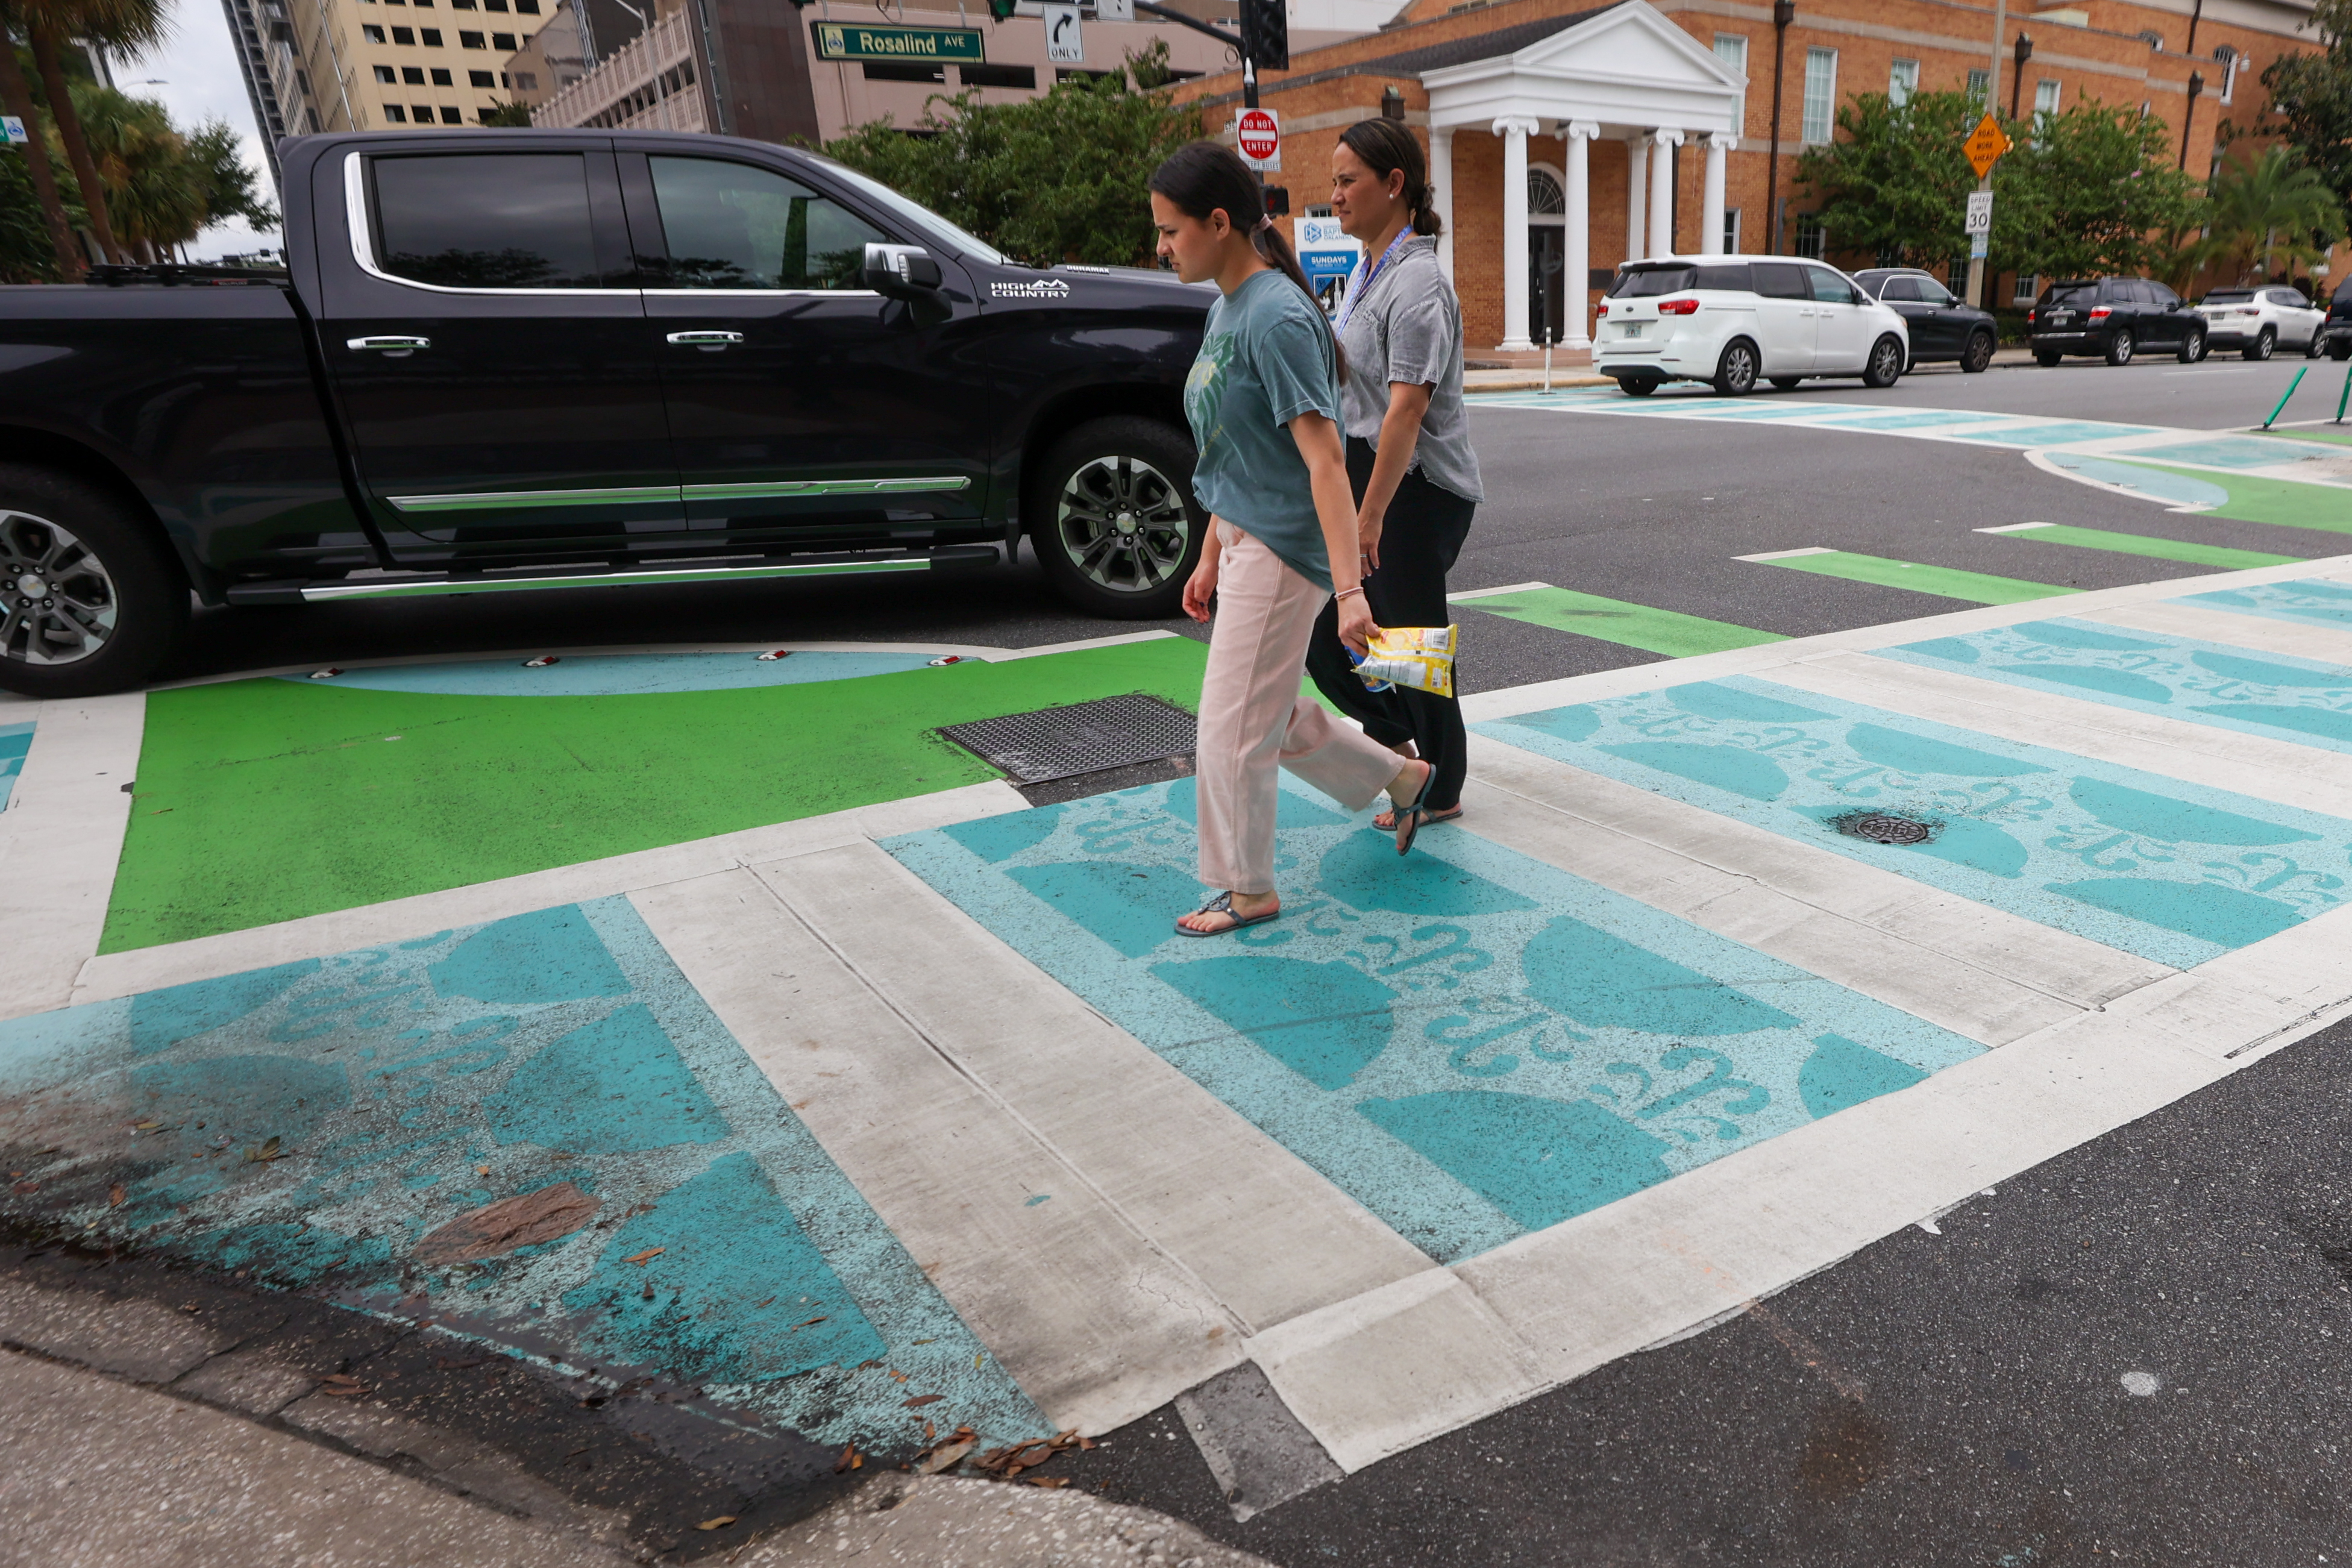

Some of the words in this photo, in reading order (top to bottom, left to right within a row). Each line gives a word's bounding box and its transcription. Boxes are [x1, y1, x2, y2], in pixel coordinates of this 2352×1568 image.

[859, 31, 936, 55] Rosalind
[944, 35, 965, 48] AVE
[1051, 46, 1079, 59] ONLY
[1243, 119, 1253, 129] DO
[1257, 120, 1272, 130] NOT
[1977, 128, 1995, 138] ROAD
[1246, 142, 1272, 152] ENTER
[1977, 141, 1993, 150] WORK
[1973, 152, 1994, 162] AHEAD
[1245, 160, 1259, 169] CEPT
[1262, 161, 1279, 171] BUSES
[1969, 212, 1988, 228] 30
[1311, 256, 1347, 265] SUNDAYS
[1067, 265, 1109, 274] DURAMAX
[991, 290, 1070, 298] COUNTRY
